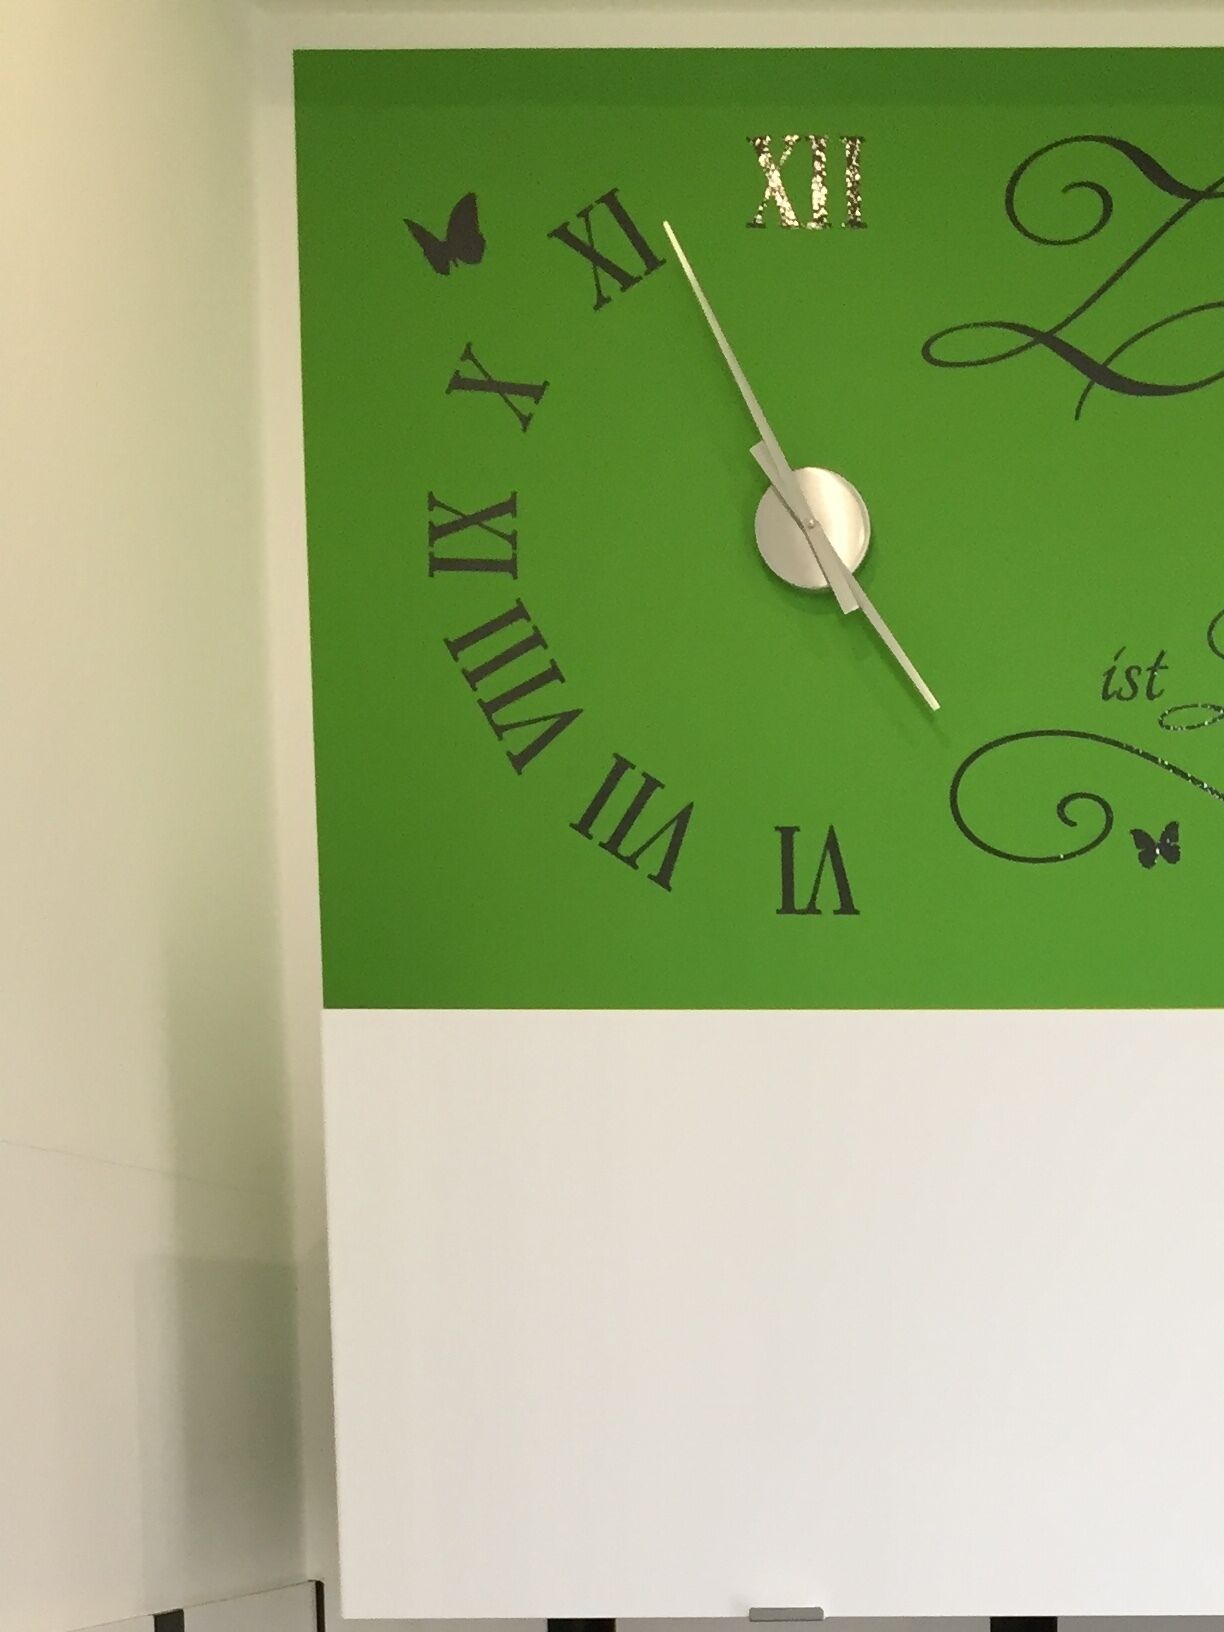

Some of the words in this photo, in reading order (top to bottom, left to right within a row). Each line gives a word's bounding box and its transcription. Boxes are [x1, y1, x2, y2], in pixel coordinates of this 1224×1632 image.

[746, 134, 867, 230] XII
[547, 188, 667, 311] XI
[445, 342, 550, 432] X
[427, 491, 518, 579] IX
[443, 598, 583, 776] VIII
[1101, 647, 1168, 701] ist
[570, 752, 695, 892] VII
[775, 825, 860, 916] VI
